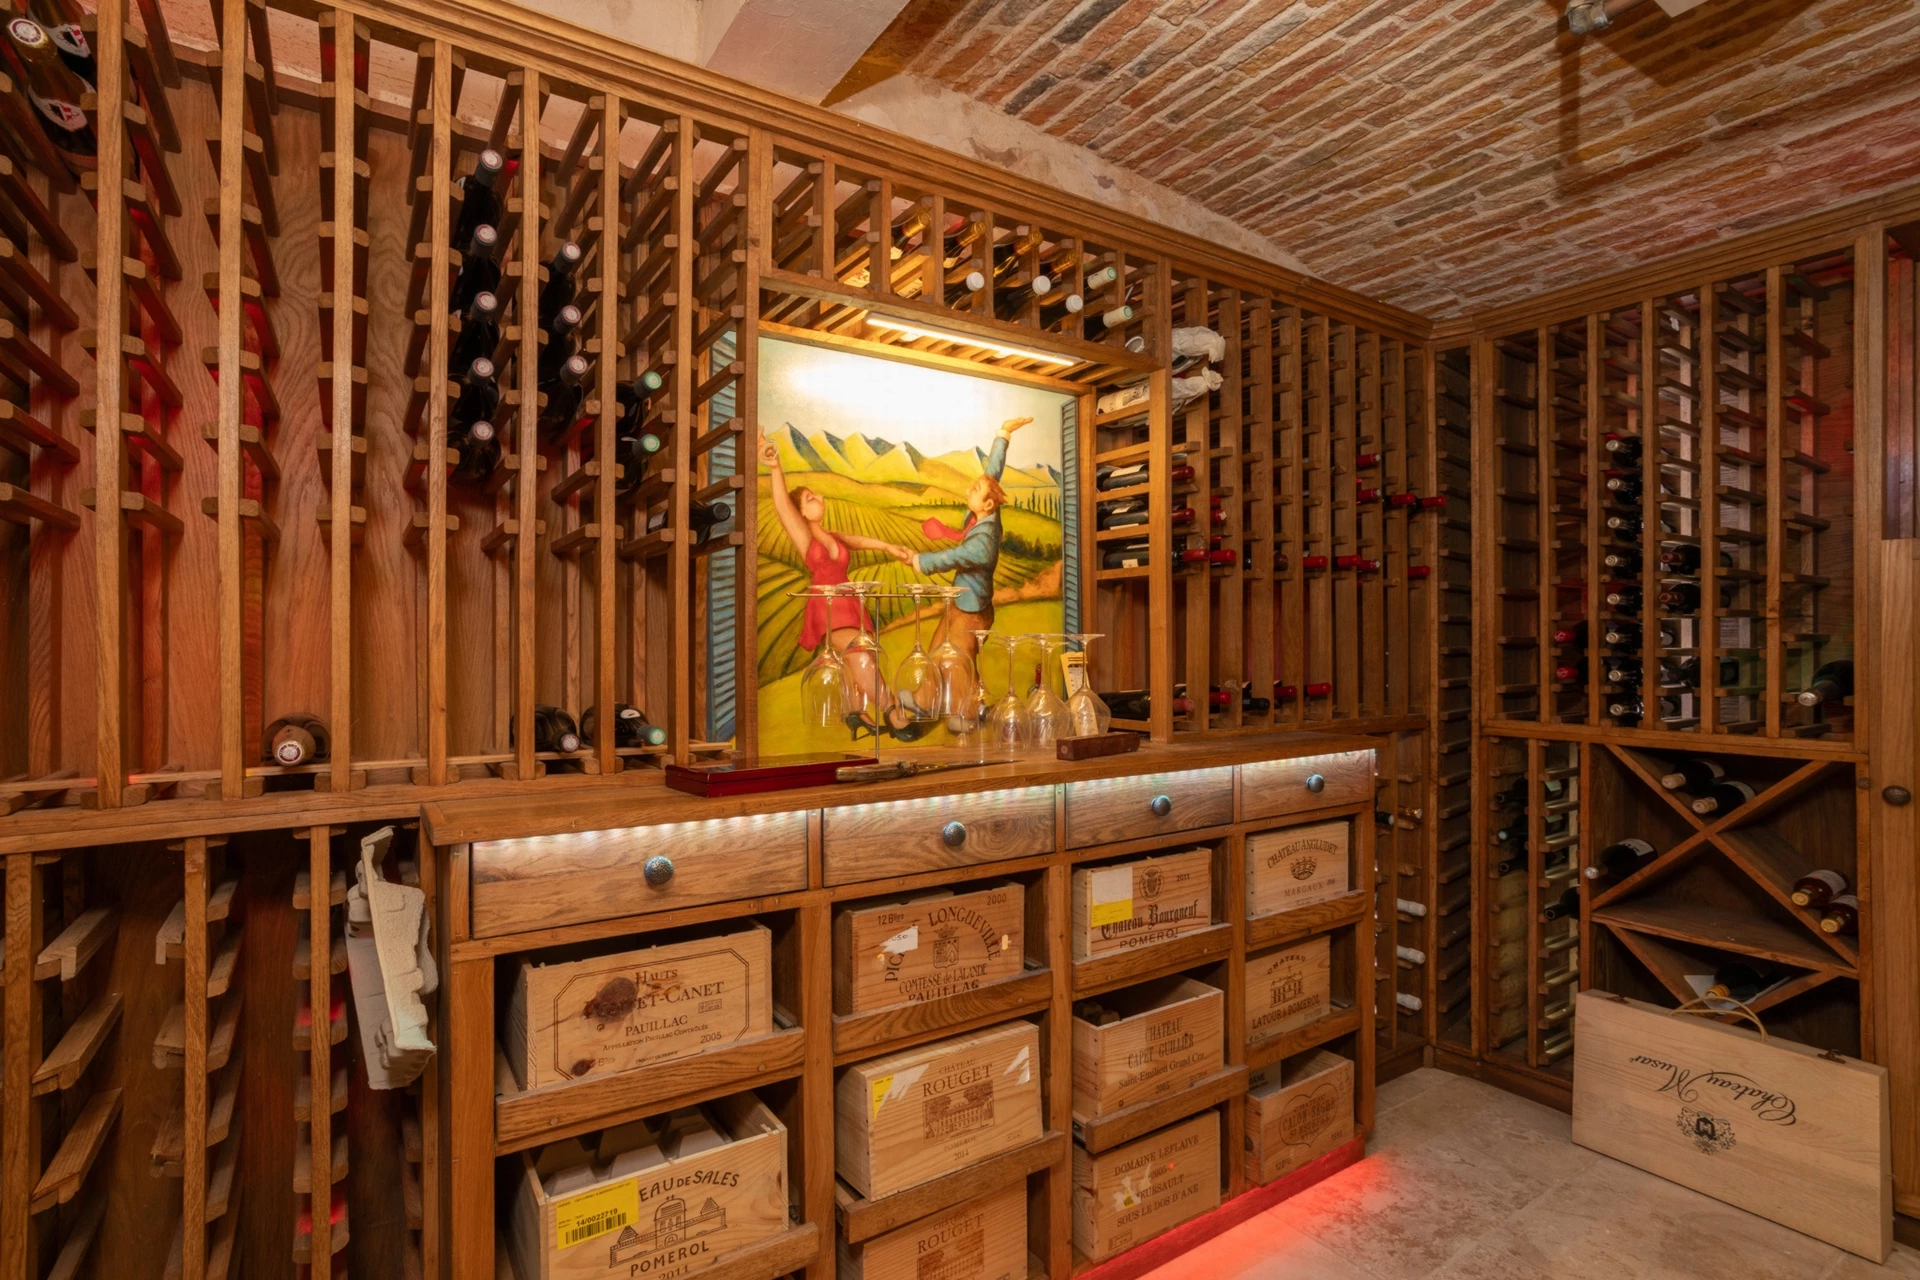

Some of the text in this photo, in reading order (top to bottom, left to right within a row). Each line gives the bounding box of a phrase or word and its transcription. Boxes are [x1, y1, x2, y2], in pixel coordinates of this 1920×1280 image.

[1267, 841, 1301, 869] CHATEAU
[986, 894, 1007, 906] 2000
[1284, 881, 1324, 897] MARGAUX
[928, 906, 1001, 961] LONGUEVILLE
[635, 969, 678, 986] HAUTS
[900, 972, 942, 995] COMTESSE
[634, 981, 725, 1010] ET-CANET
[625, 1014, 688, 1037] PAUILLAC
[700, 1031, 722, 1044] 2005
[922, 1063, 993, 1097] ROUGET
[1628, 1054, 1797, 1127] Chateau Musar
[1114, 1134, 1200, 1177] DOMAINE LEFLAIVE
[692, 1170, 740, 1188] SALES
[576, 1208, 618, 1227] 14/0022719
[1116, 1207, 1140, 1228] SOUS
[1141, 1204, 1153, 1218] LE
[918, 1213, 984, 1254] ROUGET
[630, 1241, 710, 1277] POMEROL
[658, 1264, 690, 1280] 2011
